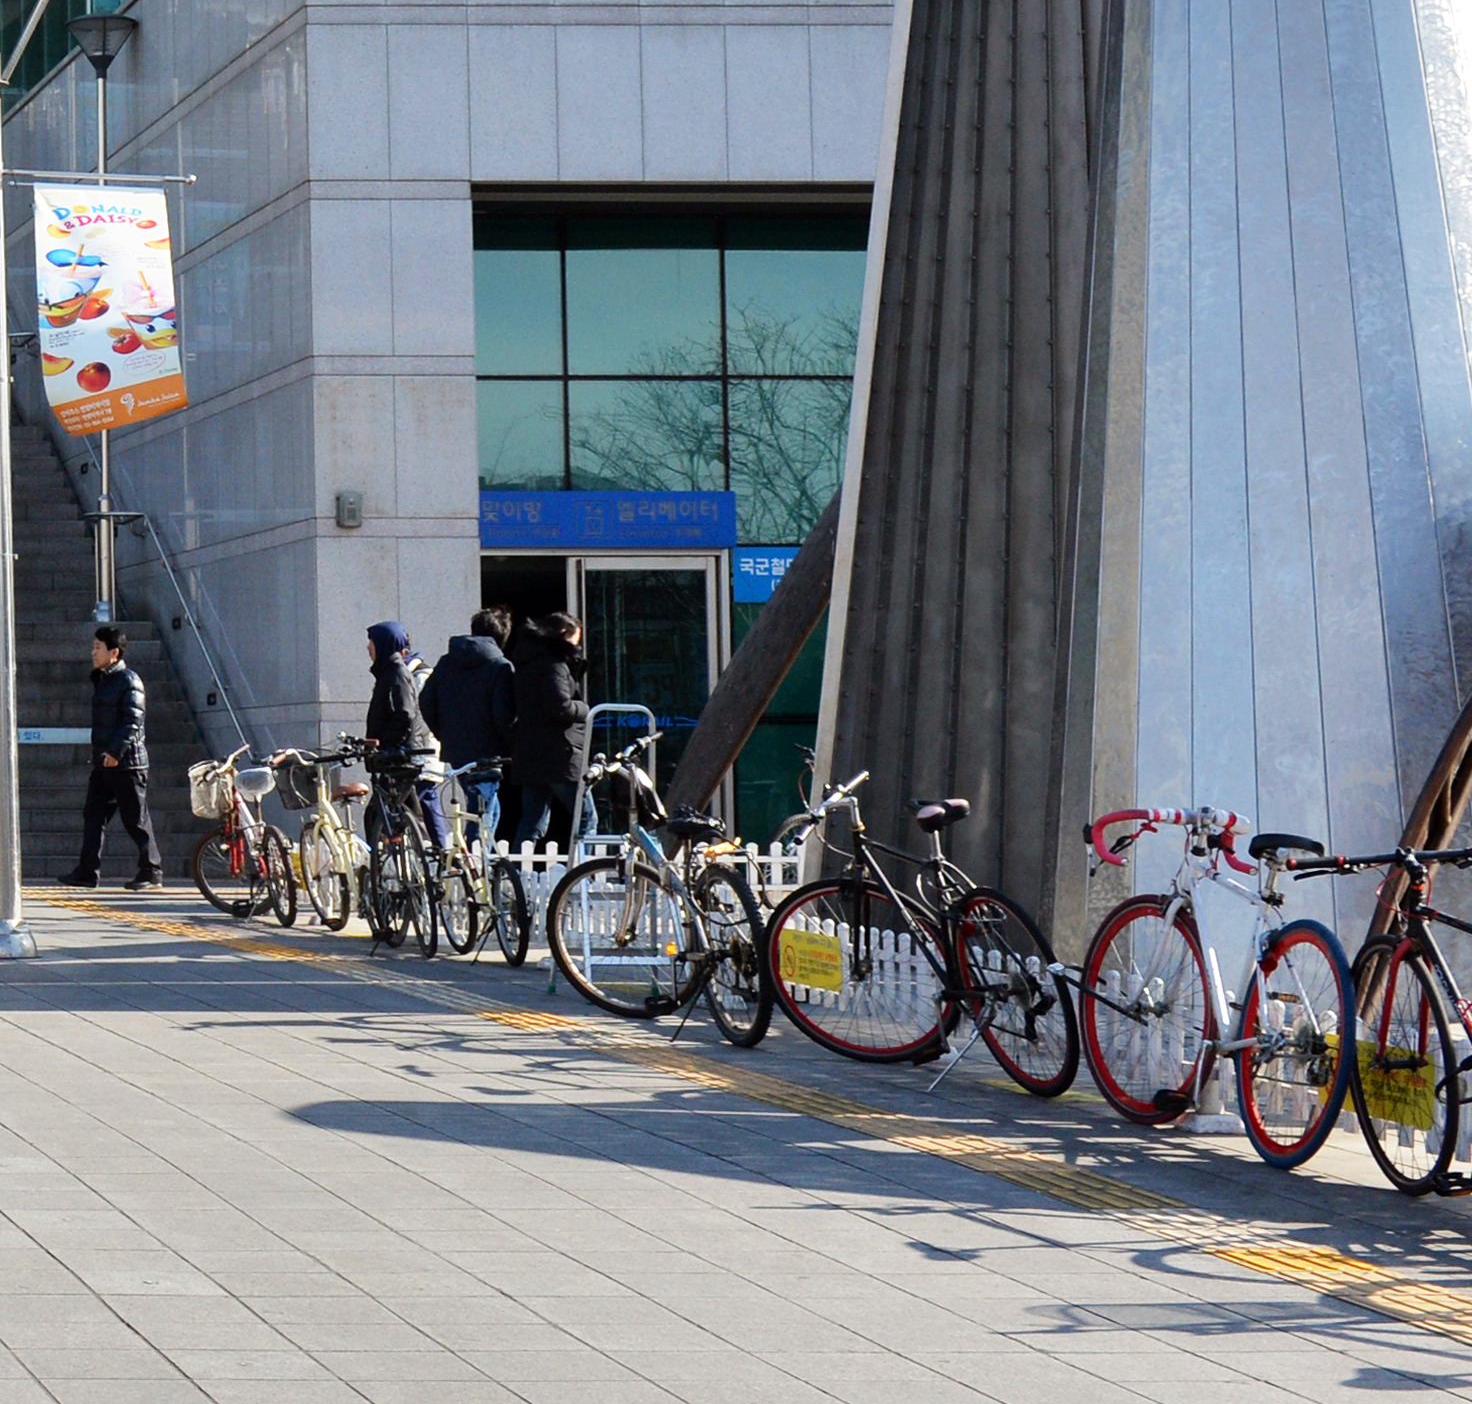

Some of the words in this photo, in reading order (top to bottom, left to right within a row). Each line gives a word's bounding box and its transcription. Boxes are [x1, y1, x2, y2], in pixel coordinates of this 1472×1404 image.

[63, 220, 76, 230] &
[74, 213, 139, 228] DAISY
[618, 499, 718, 522] 엘리베이터
